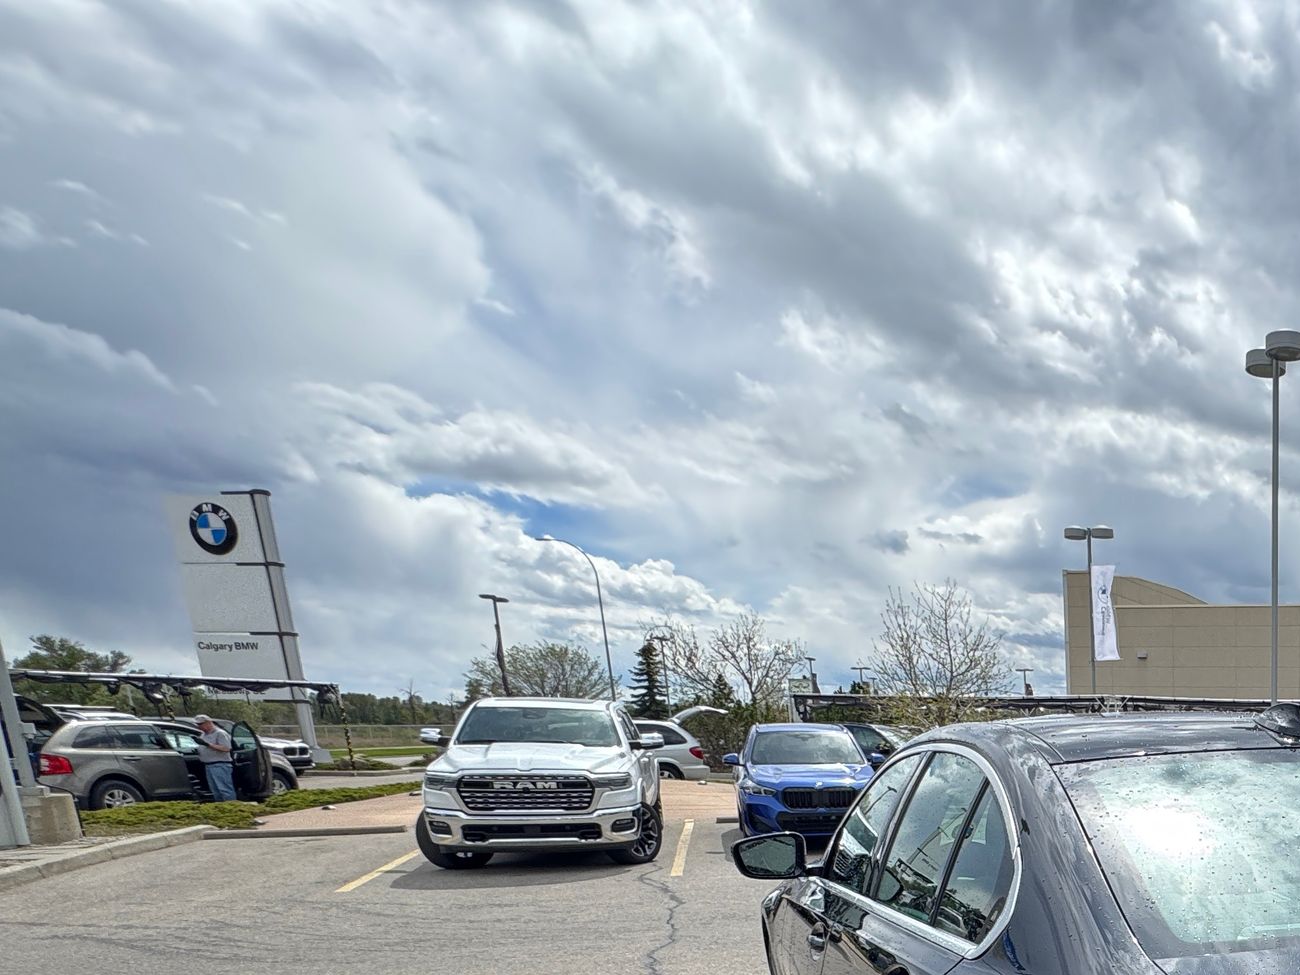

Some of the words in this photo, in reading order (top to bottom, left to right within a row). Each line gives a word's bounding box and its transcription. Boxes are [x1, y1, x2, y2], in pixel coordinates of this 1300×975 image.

[197, 641, 234, 652] Calgary
[234, 642, 259, 650] BMW
[492, 781, 558, 790] RAM
